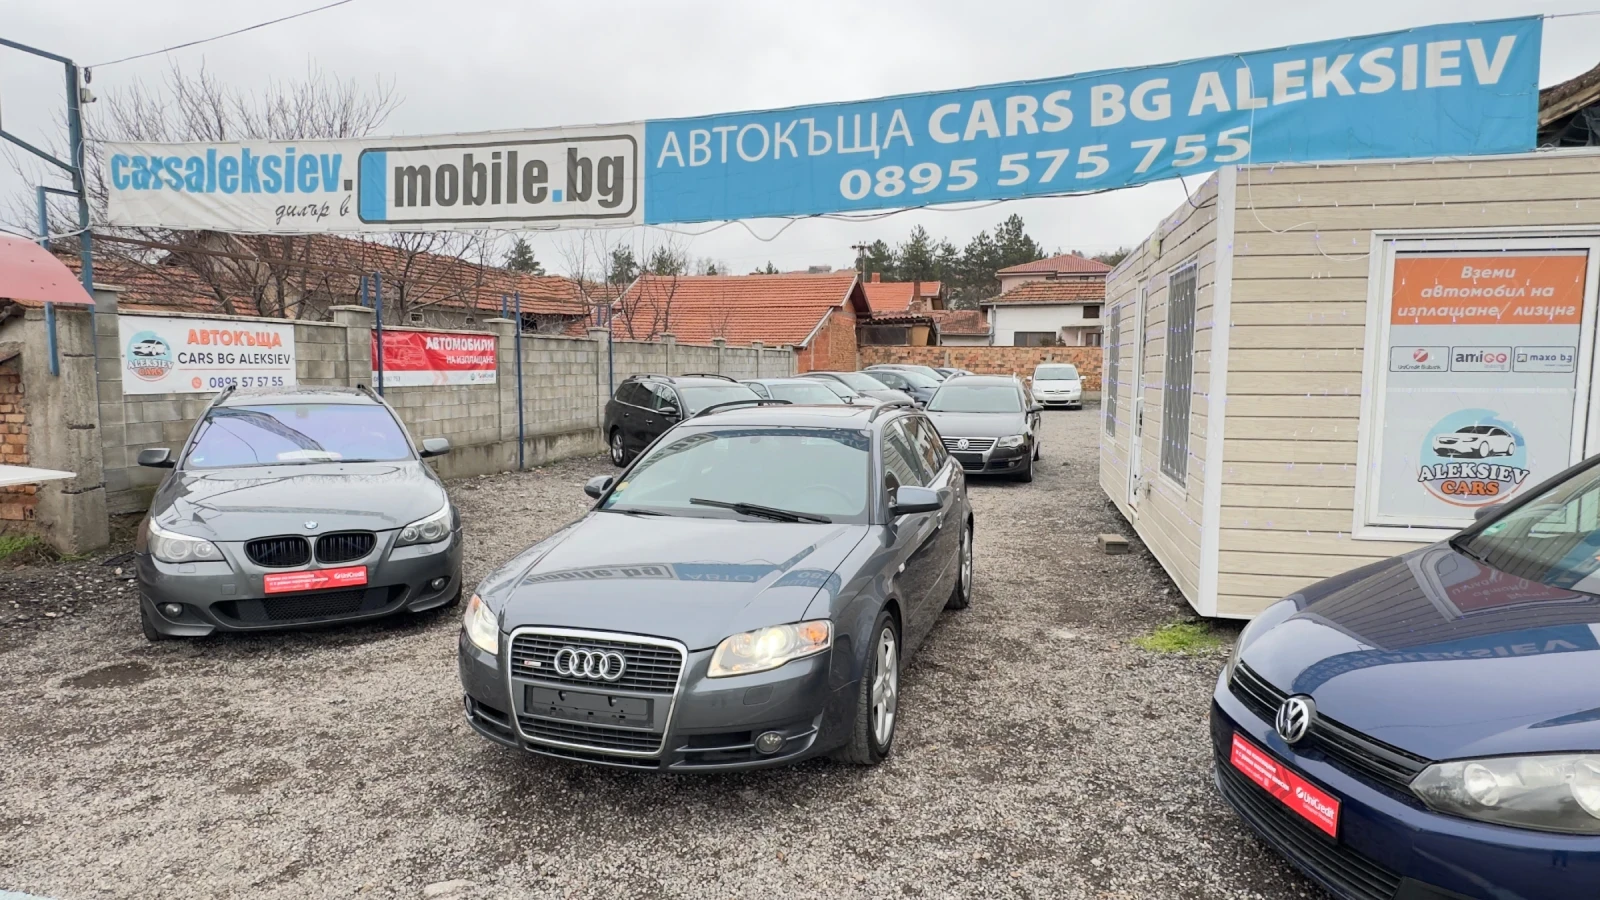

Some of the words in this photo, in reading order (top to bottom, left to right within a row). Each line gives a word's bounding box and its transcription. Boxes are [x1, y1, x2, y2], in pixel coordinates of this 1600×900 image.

[657, 108, 914, 168] АВТОКЪЩА
[927, 89, 1075, 144] CARS
[1090, 78, 1173, 127] BG
[1188, 35, 1517, 117] ALEKSIEV
[840, 158, 979, 201] 0895
[997, 143, 1110, 188] 575
[1130, 125, 1251, 175] 755
[394, 147, 625, 209] mobile.bg
[1460, 265, 1517, 280] Вземи
[1420, 284, 1526, 298] автомобил
[1530, 286, 1555, 298] на
[1513, 304, 1576, 318] лизинг
[187, 328, 282, 350] АВТОКЪЩА
[425, 336, 495, 351] АВТОМОБИЛИ
[127, 358, 175, 370] ALEKSIEV
[178, 352, 214, 365] CARS
[217, 353, 236, 365] BG
[239, 353, 291, 365] ALEKSIEV
[446, 355, 456, 364] НА
[241, 376, 254, 388] 57
[257, 376, 269, 387] 57
[271, 376, 284, 387] 55
[1418, 462, 1530, 484] ALEKSIEV
[1441, 480, 1499, 495] CARS
[1303, 791, 1335, 820] UniCredit
